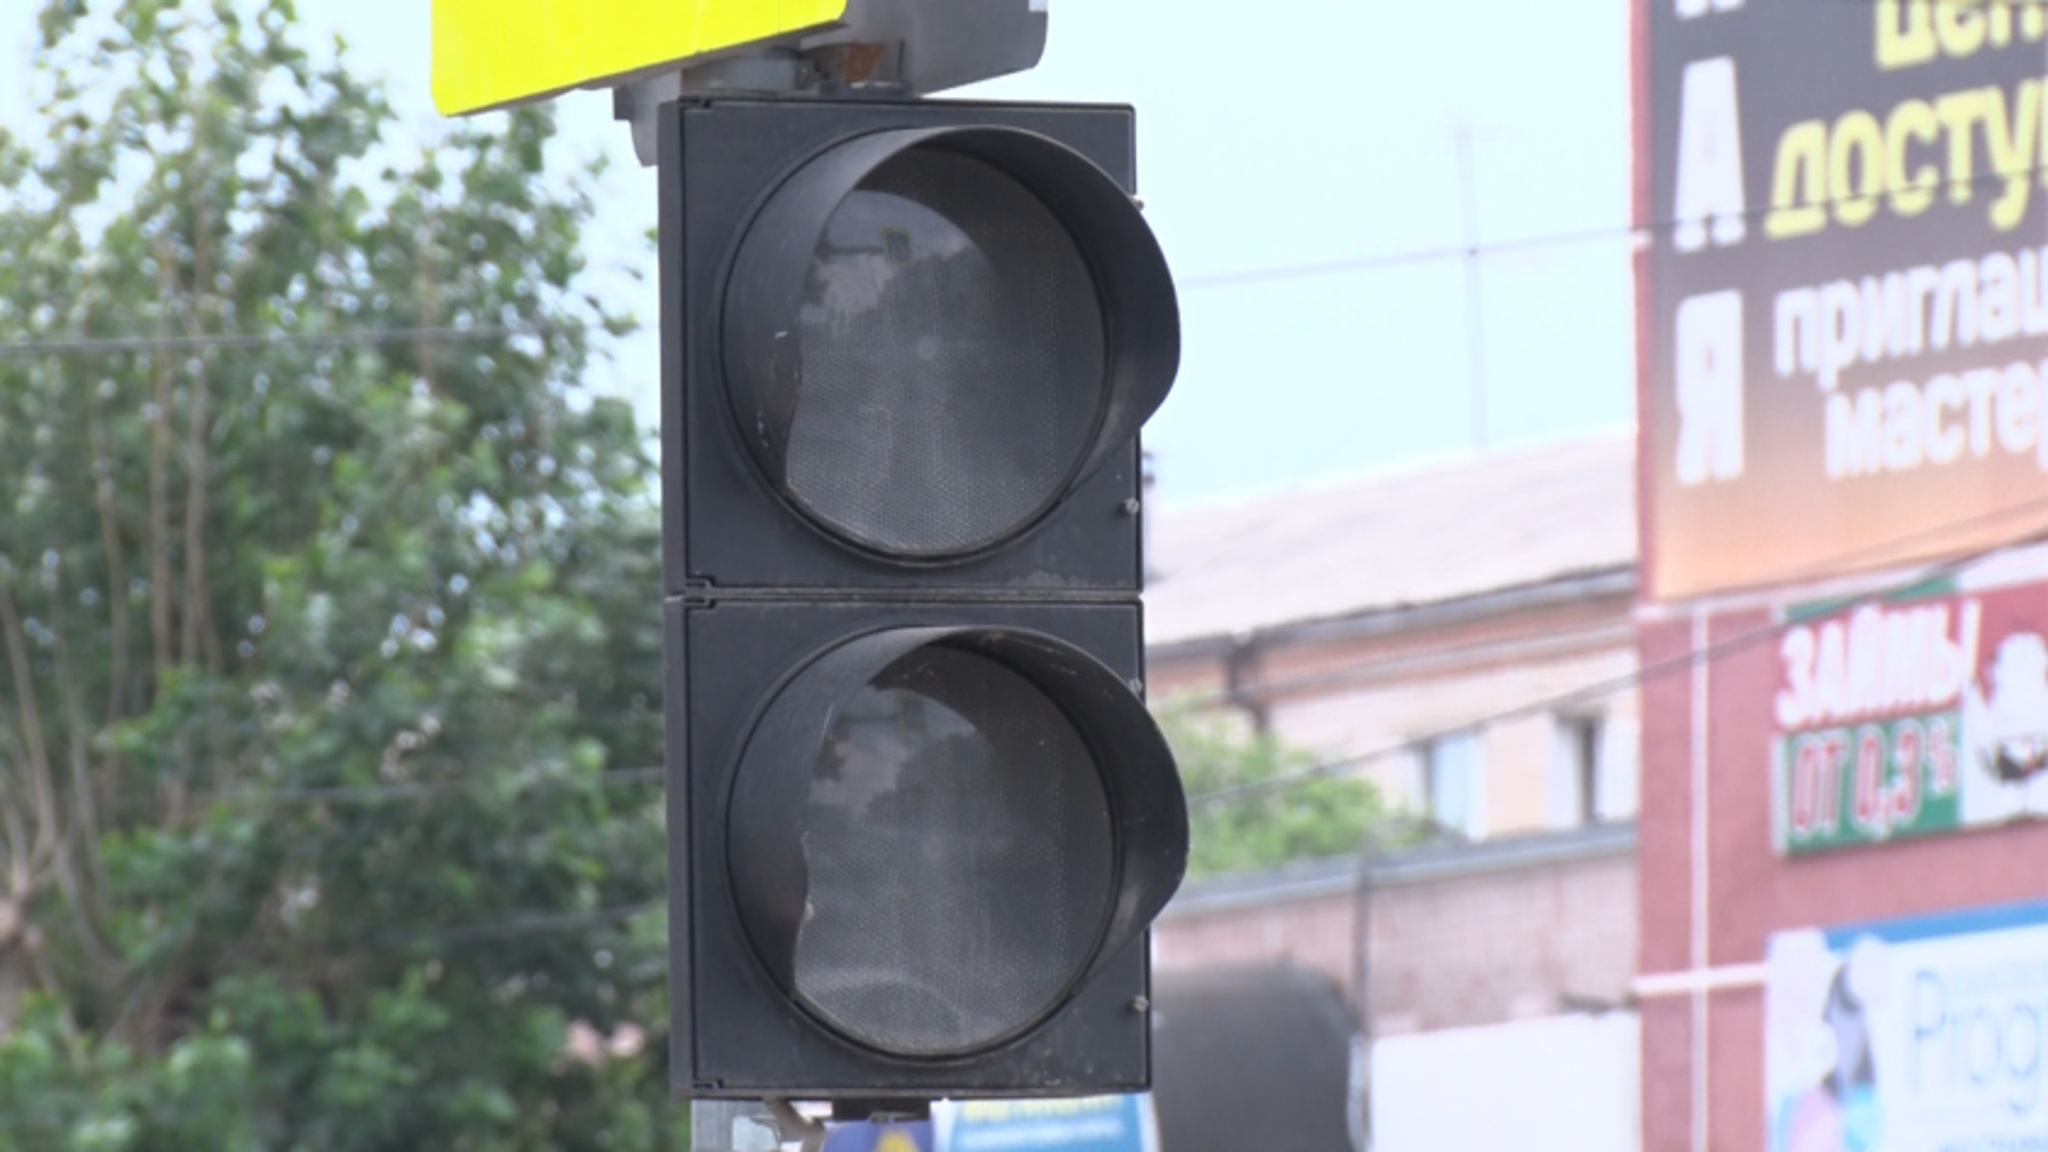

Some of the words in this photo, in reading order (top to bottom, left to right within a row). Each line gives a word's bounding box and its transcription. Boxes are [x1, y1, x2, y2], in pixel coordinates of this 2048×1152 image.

[1764, 74, 2048, 240] досту
[1825, 356, 2048, 481] масте
[1775, 600, 1981, 730] ЗАЙМЫ
[1912, 967, 2048, 1114] Prog
